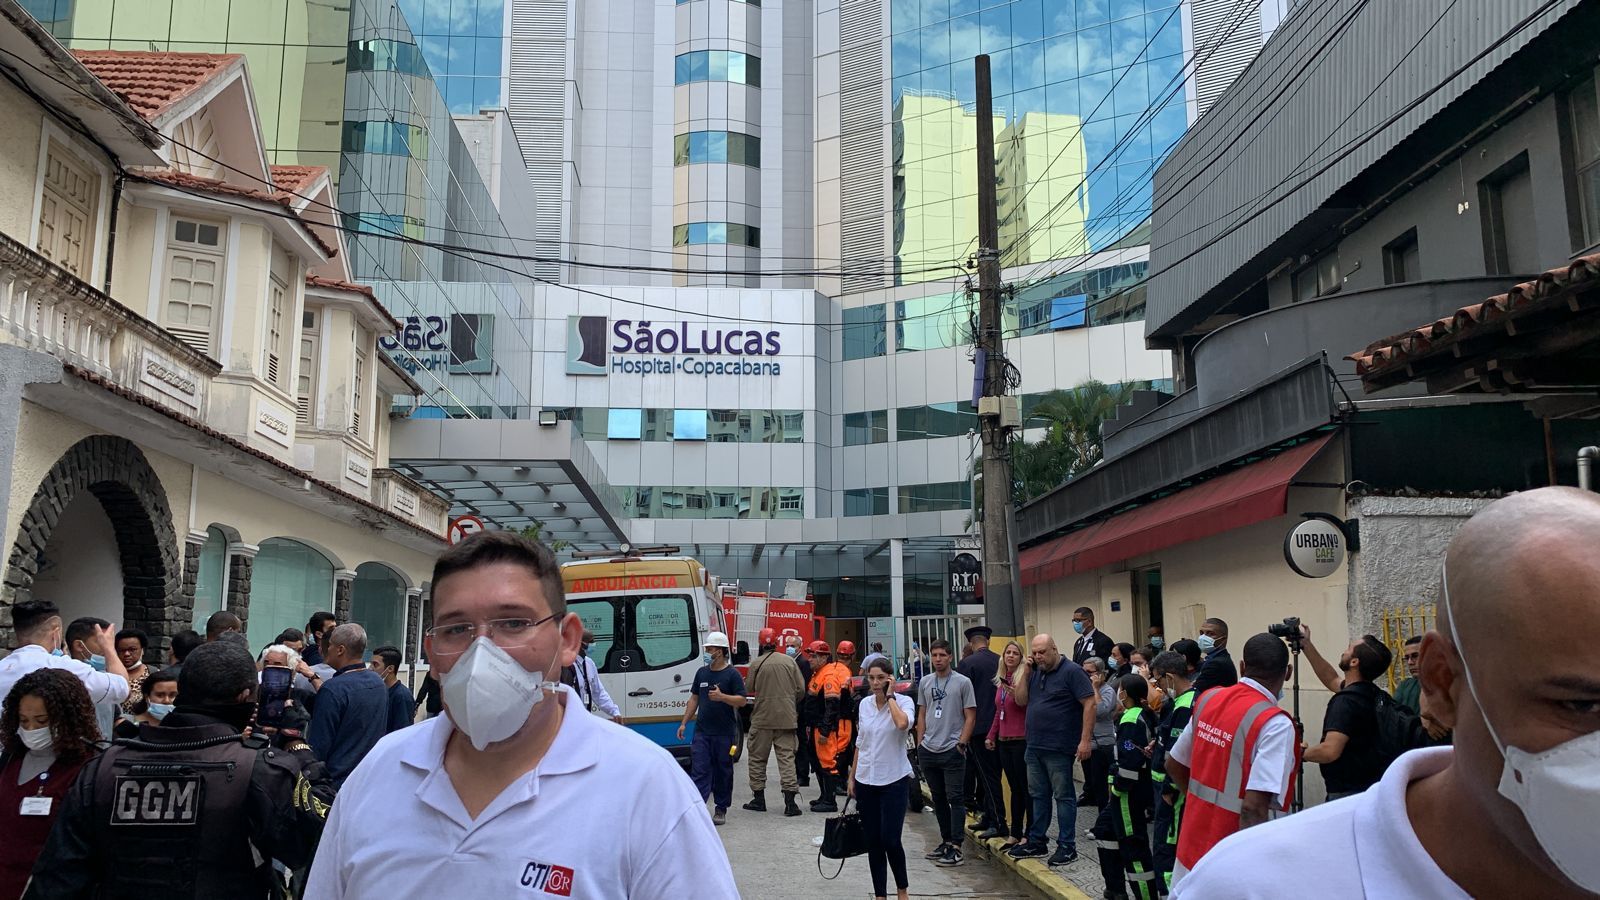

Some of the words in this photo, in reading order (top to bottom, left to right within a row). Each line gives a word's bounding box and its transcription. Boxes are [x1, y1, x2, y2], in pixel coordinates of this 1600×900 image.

[1295, 533, 1339, 548] URBANO
[571, 573, 678, 593] AMBULÂNCIA
[769, 611, 808, 620] SALVAMENTO
[637, 701, 689, 709] (21)2545-366
[1222, 731, 1232, 742] DE
[116, 781, 196, 820] GGM
